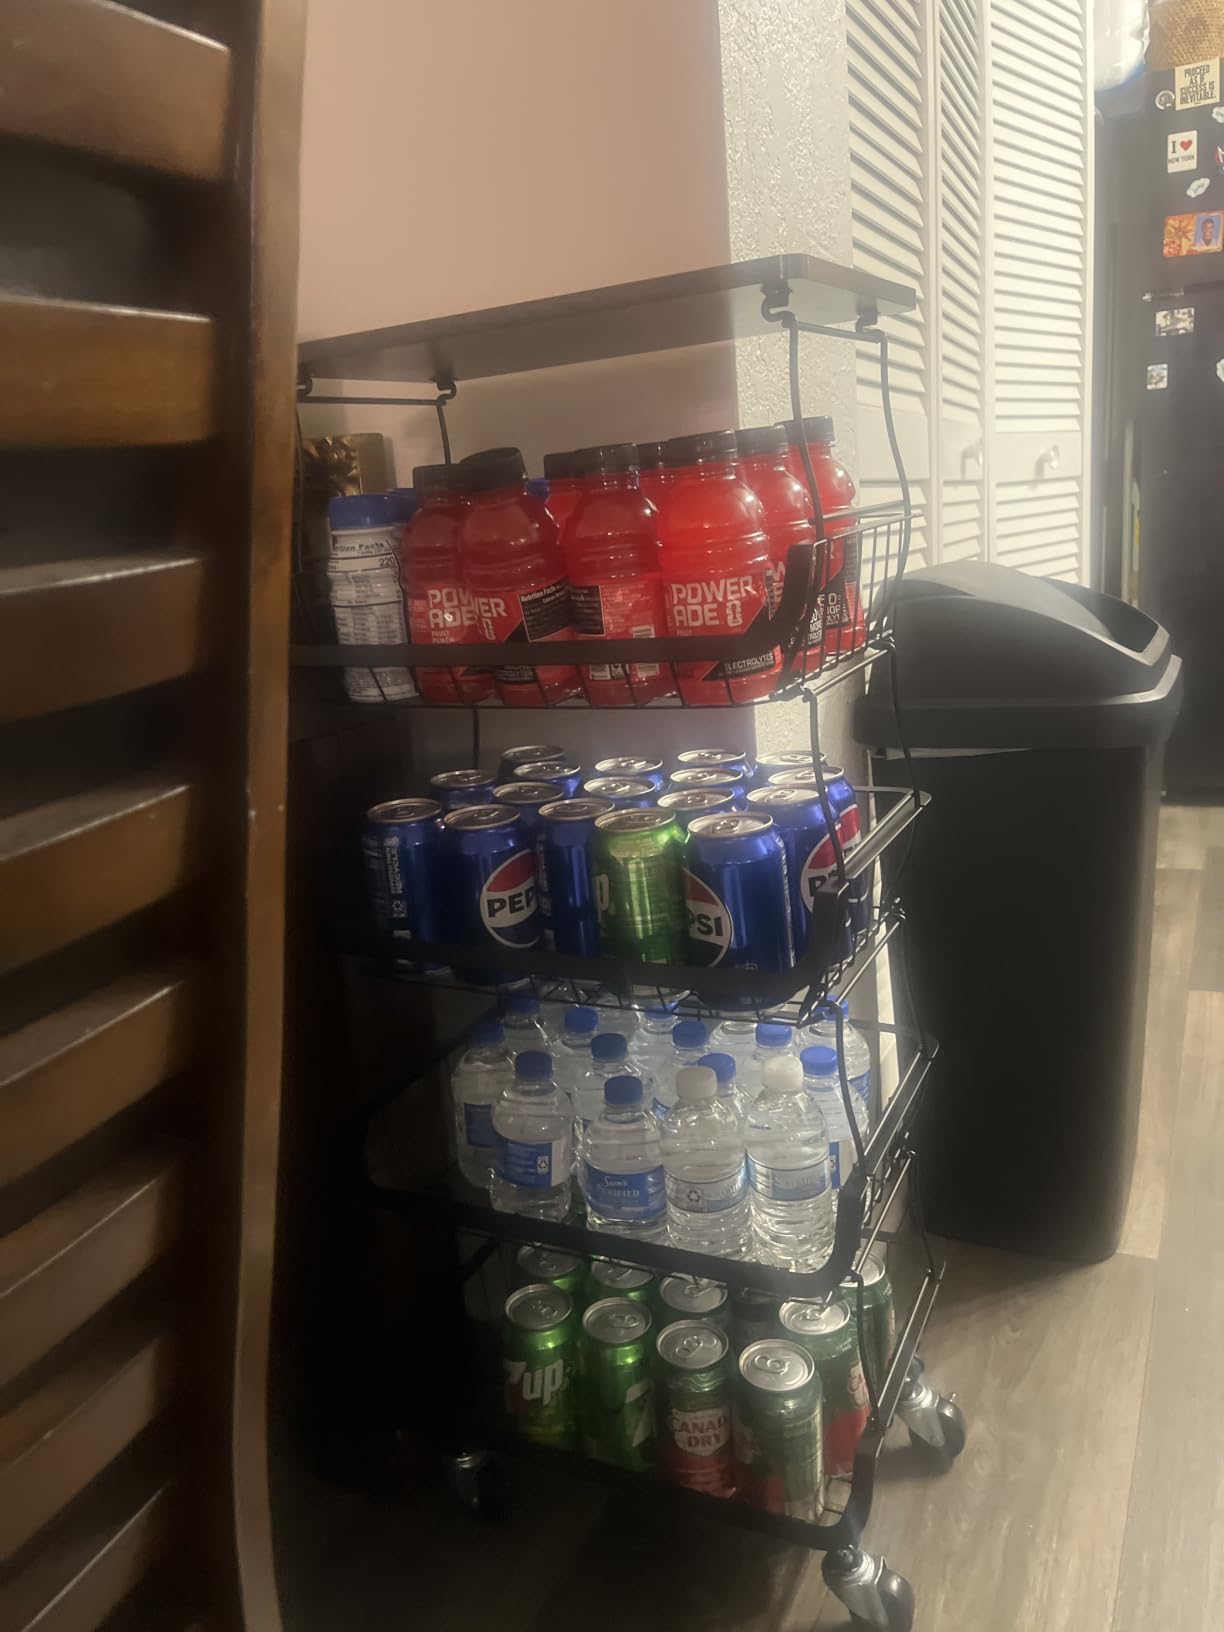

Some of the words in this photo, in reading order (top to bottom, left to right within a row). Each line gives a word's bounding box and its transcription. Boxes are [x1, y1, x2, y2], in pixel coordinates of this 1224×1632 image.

[1184, 64, 1210, 78] PROCEED
[1189, 76, 1198, 86] AS
[1199, 74, 1205, 84] IF
[1180, 82, 1207, 96] SUCCESS
[1208, 81, 1215, 90] IS
[1171, 140, 1177, 154] I
[671, 576, 756, 604] POWER
[429, 606, 477, 629] ADE
[673, 603, 720, 627] ADE
